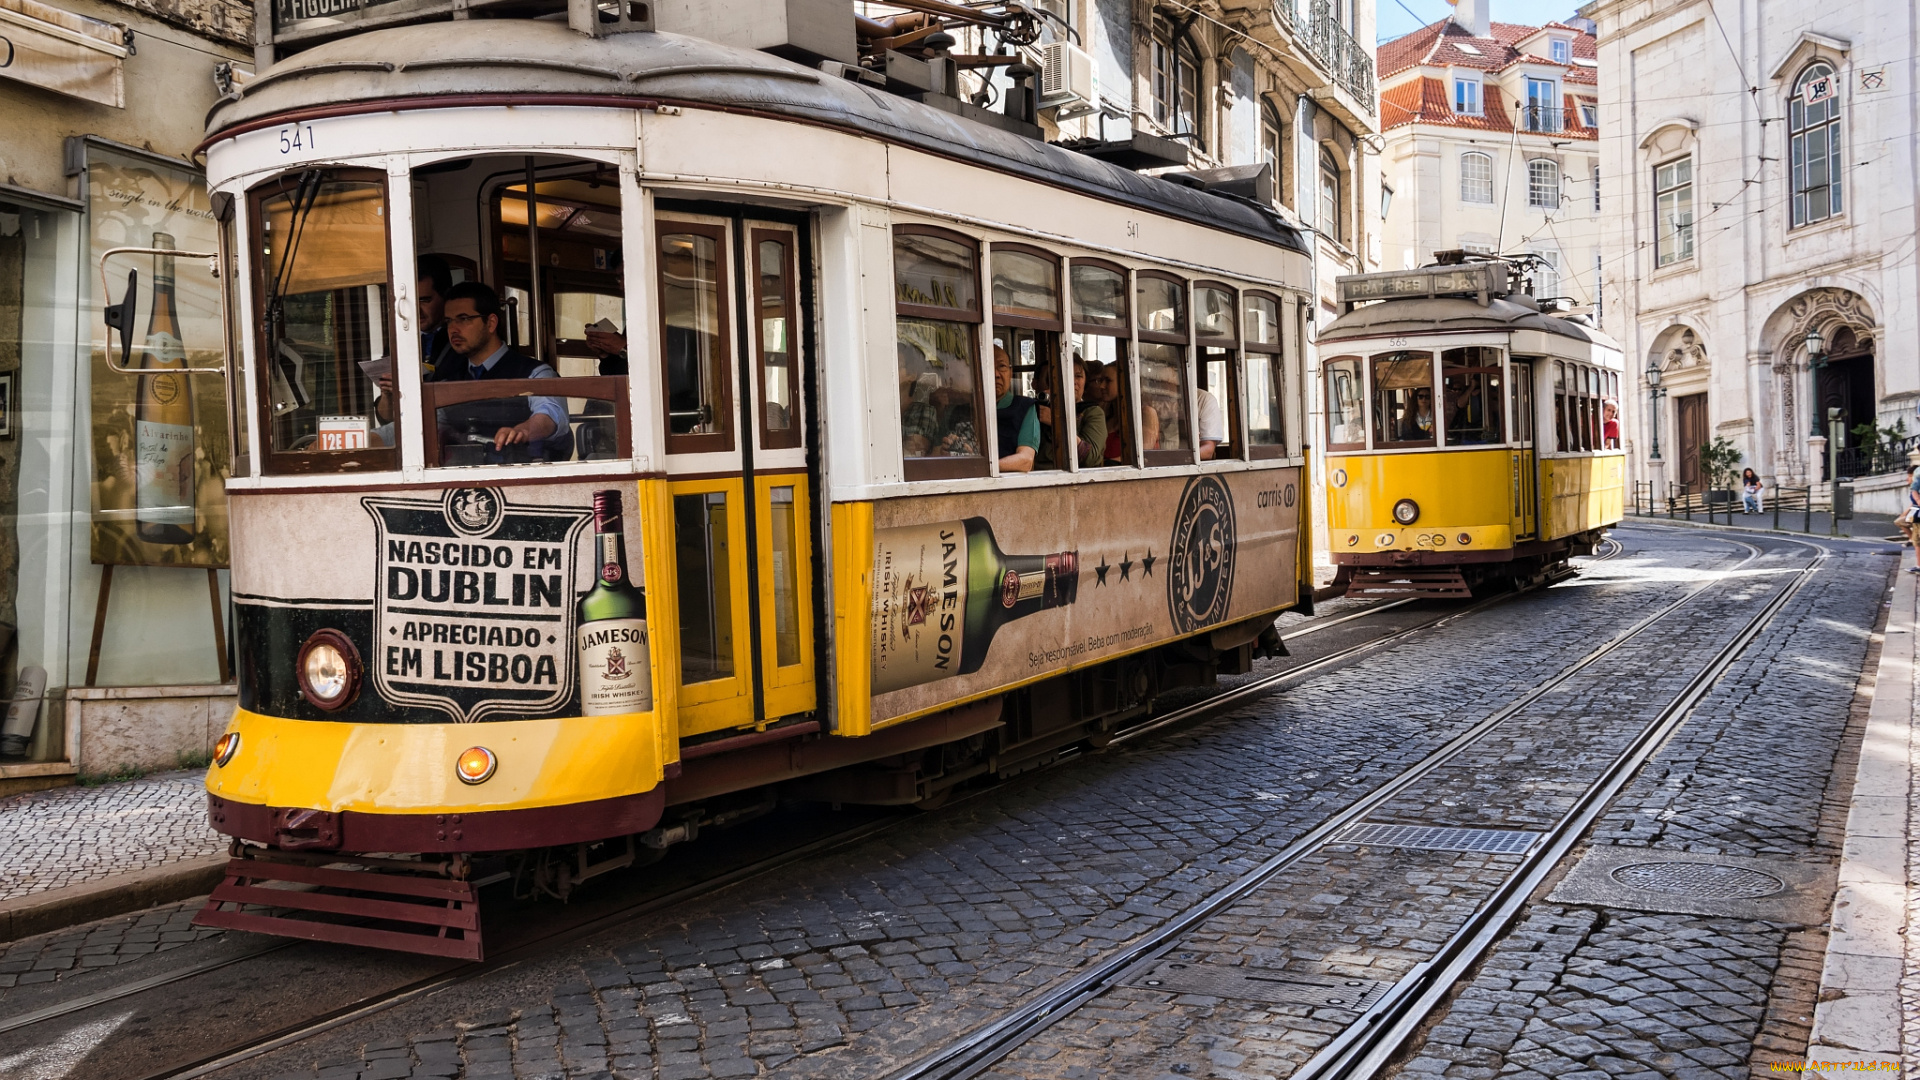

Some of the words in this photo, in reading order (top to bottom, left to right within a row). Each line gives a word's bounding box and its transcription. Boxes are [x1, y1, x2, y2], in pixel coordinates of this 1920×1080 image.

[280, 126, 316, 154] 541
[109, 190, 145, 207] single
[148, 198, 160, 208] in
[165, 199, 183, 213] the
[1127, 221, 1139, 238] 541
[1390, 338, 1407, 347] 565
[322, 433, 342, 450] 12E
[1257, 484, 1282, 508] carris
[1175, 514, 1191, 583] JOHN
[1192, 486, 1228, 530] JAMESON
[388, 540, 513, 568] NASCIDO
[523, 547, 562, 570] EM
[884, 551, 892, 593] IRISH
[387, 566, 562, 607] DUBLIN
[934, 530, 958, 672] JAMESON
[403, 621, 541, 647] APRECIADO
[582, 628, 647, 651] JAMESON
[881, 599, 889, 671] WHISKEY
[1028, 652, 1044, 669] Seja
[1045, 641, 1087, 663] responsável.
[1088, 636, 1105, 651] Beba
[1105, 633, 1120, 646] com
[1120, 622, 1155, 642] moderação.
[387, 646, 422, 678] EM
[434, 650, 558, 685] LISBOA
[612, 690, 644, 698] WHISKEY
